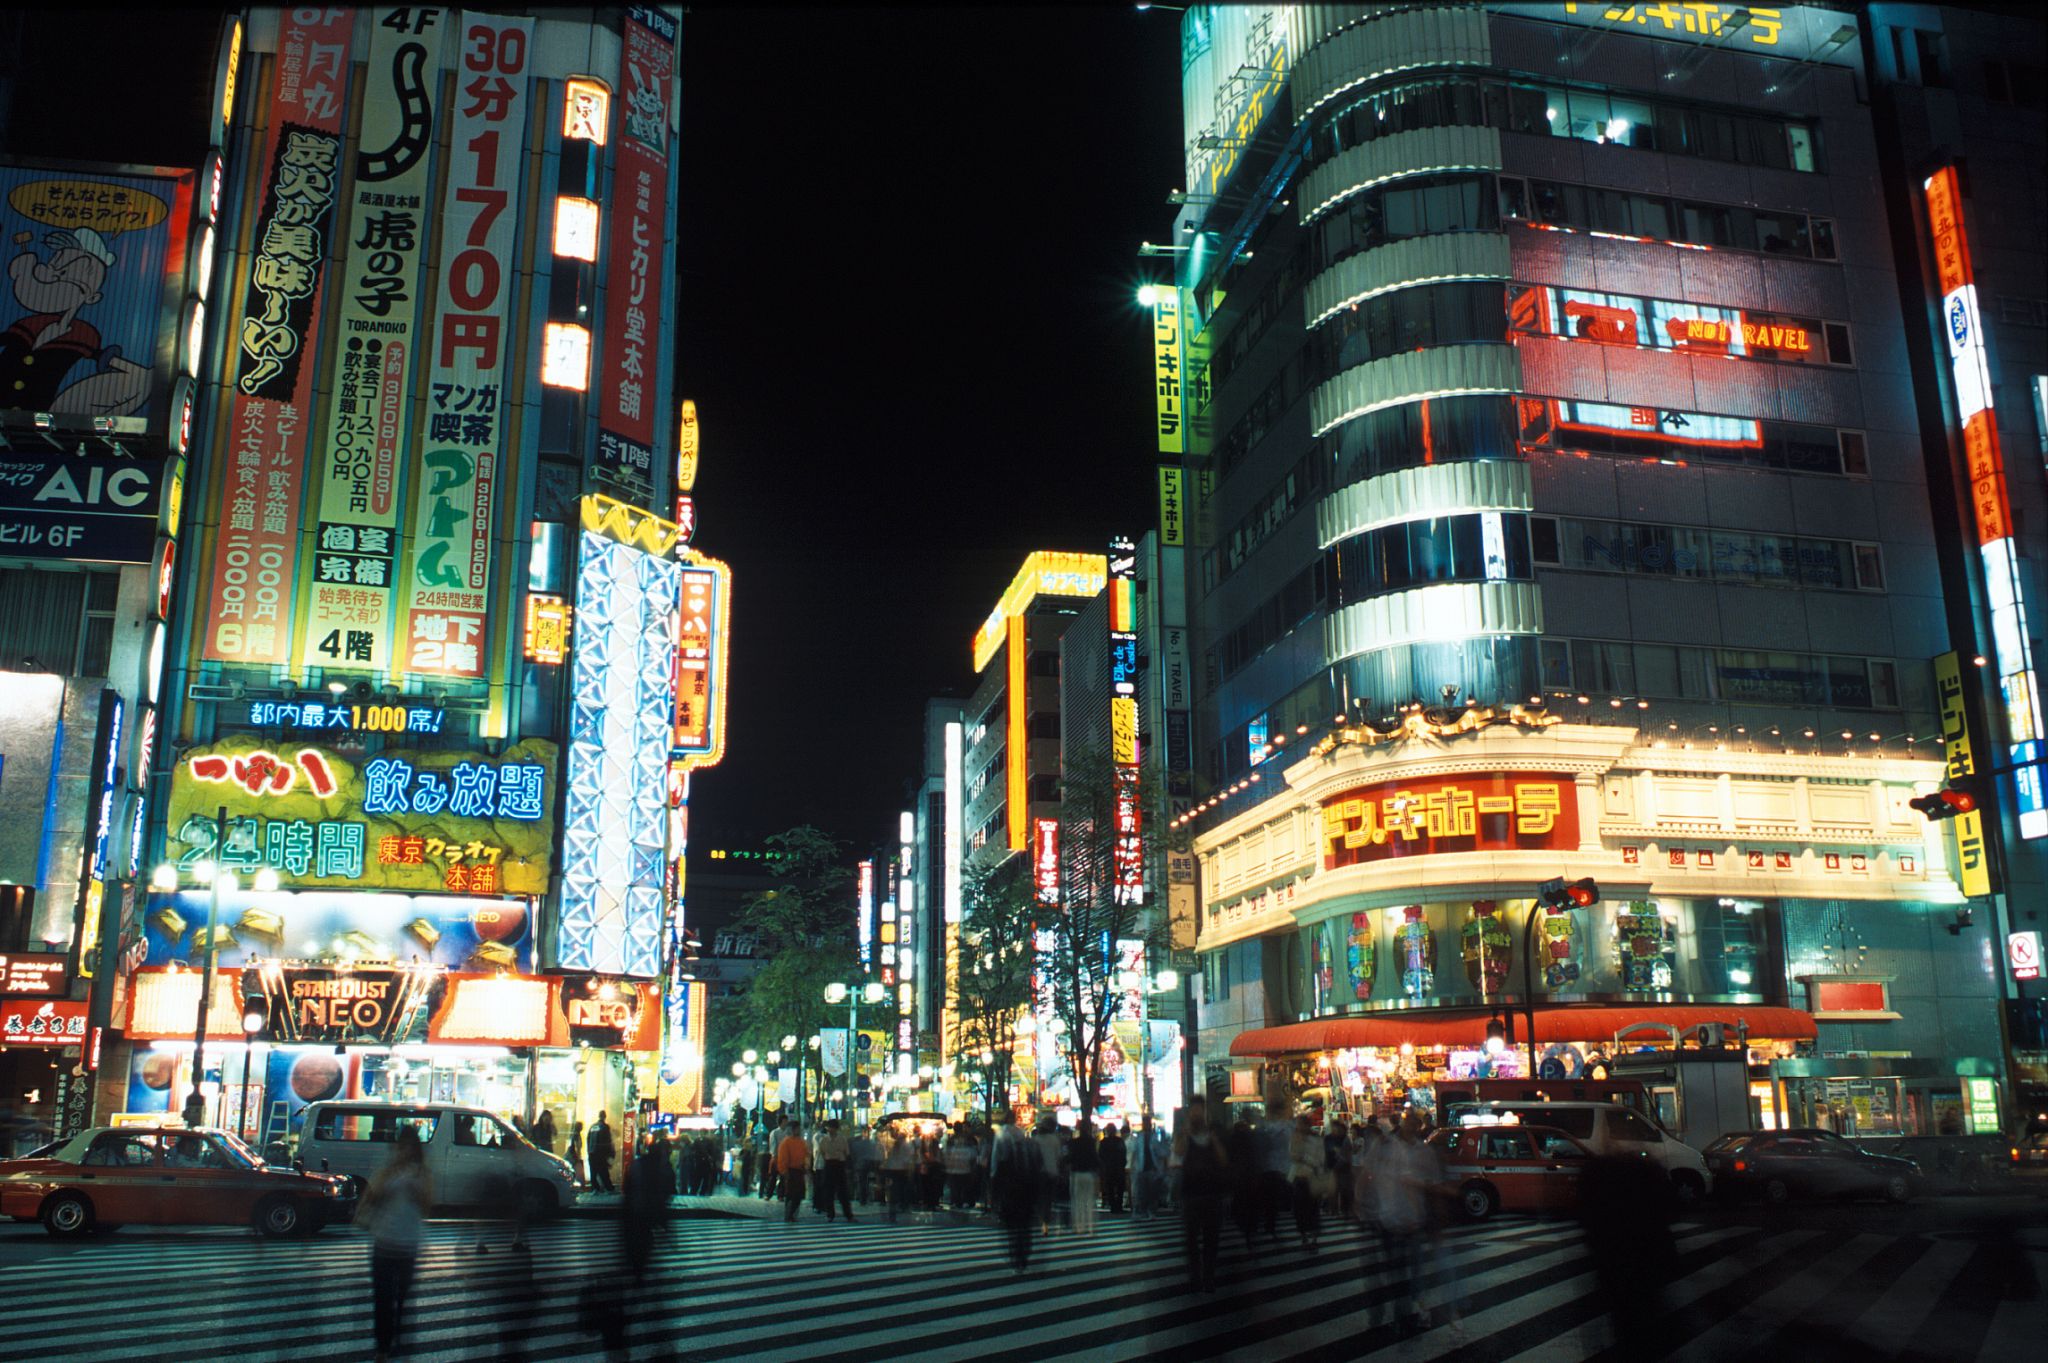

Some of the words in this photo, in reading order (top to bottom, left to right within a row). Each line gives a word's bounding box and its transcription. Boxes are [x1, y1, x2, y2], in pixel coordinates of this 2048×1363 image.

[382, 7, 440, 35] 4F
[279, 27, 306, 103] 七輪居酒屋
[462, 25, 527, 122] 30分
[359, 191, 420, 209] 居酒屋本舗
[354, 210, 417, 317] 虎の子
[439, 130, 509, 371] 170円
[431, 383, 500, 412] マンガ
[376, 380, 400, 508] 3208-9531
[430, 413, 494, 447] 喫茶
[33, 463, 150, 507] AIC
[48, 525, 85, 547] 6F
[321, 524, 390, 554] 個室
[319, 556, 386, 585] 完備
[318, 588, 384, 606] 始発待ち
[416, 591, 484, 609] 24時間営業
[412, 614, 481, 643] 地下
[318, 629, 374, 662] 4階
[410, 644, 479, 673] 2階
[1171, 663, 1182, 707] TRAVEL
[190, 748, 337, 799] つぼ八
[1937, 675, 1981, 871] ドン・キーテ
[363, 758, 545, 822] 飲み放題
[1321, 783, 1561, 856] ドン・キホーテ
[446, 864, 497, 894] 本舗
[126, 936, 149, 976] NEO
[300, 999, 382, 1028] NEO
